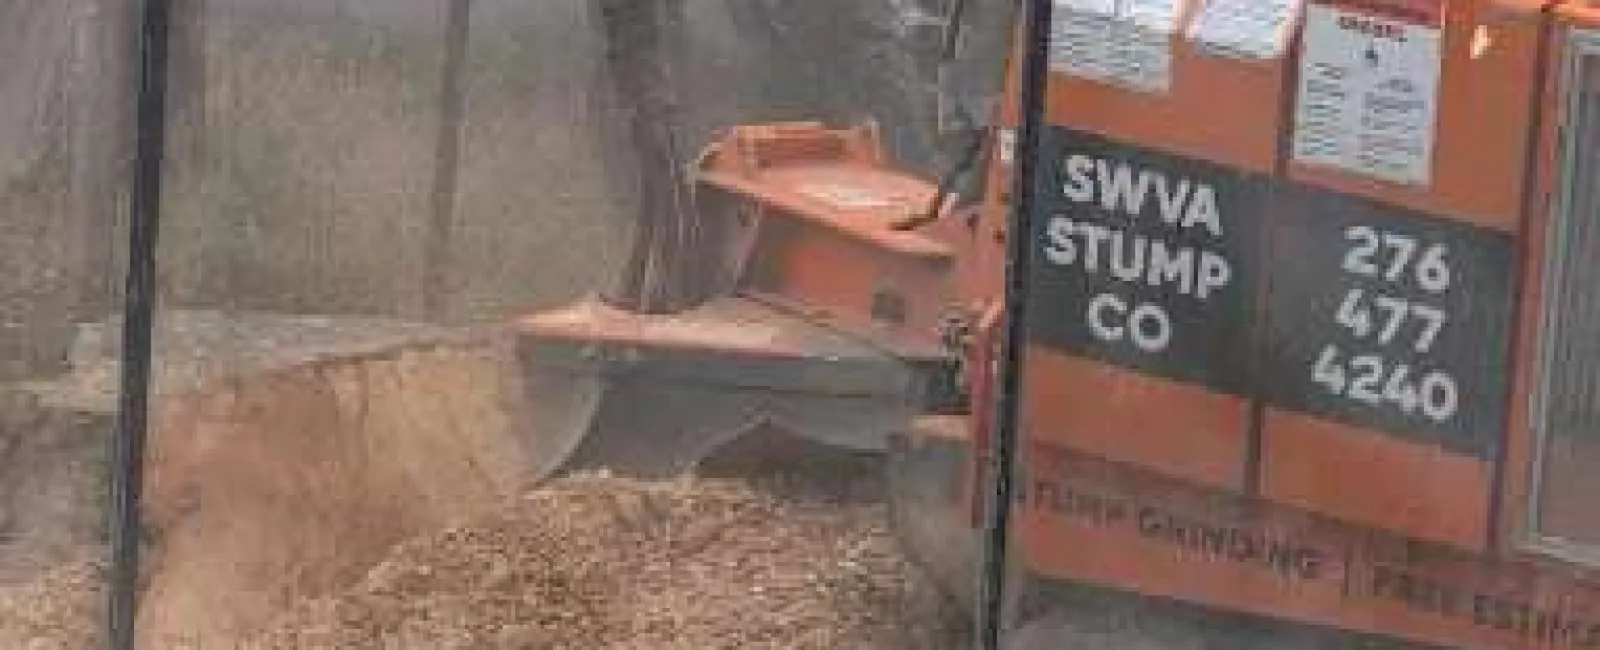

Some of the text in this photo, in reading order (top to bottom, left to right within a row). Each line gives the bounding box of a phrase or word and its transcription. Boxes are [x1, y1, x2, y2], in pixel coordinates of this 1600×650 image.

[1063, 154, 1223, 236] SWVA
[1045, 215, 1232, 299] STUMP
[1343, 225, 1451, 294] 276
[1088, 293, 1172, 352] CO
[1336, 289, 1447, 353] 477
[1311, 344, 1459, 422] 4240
